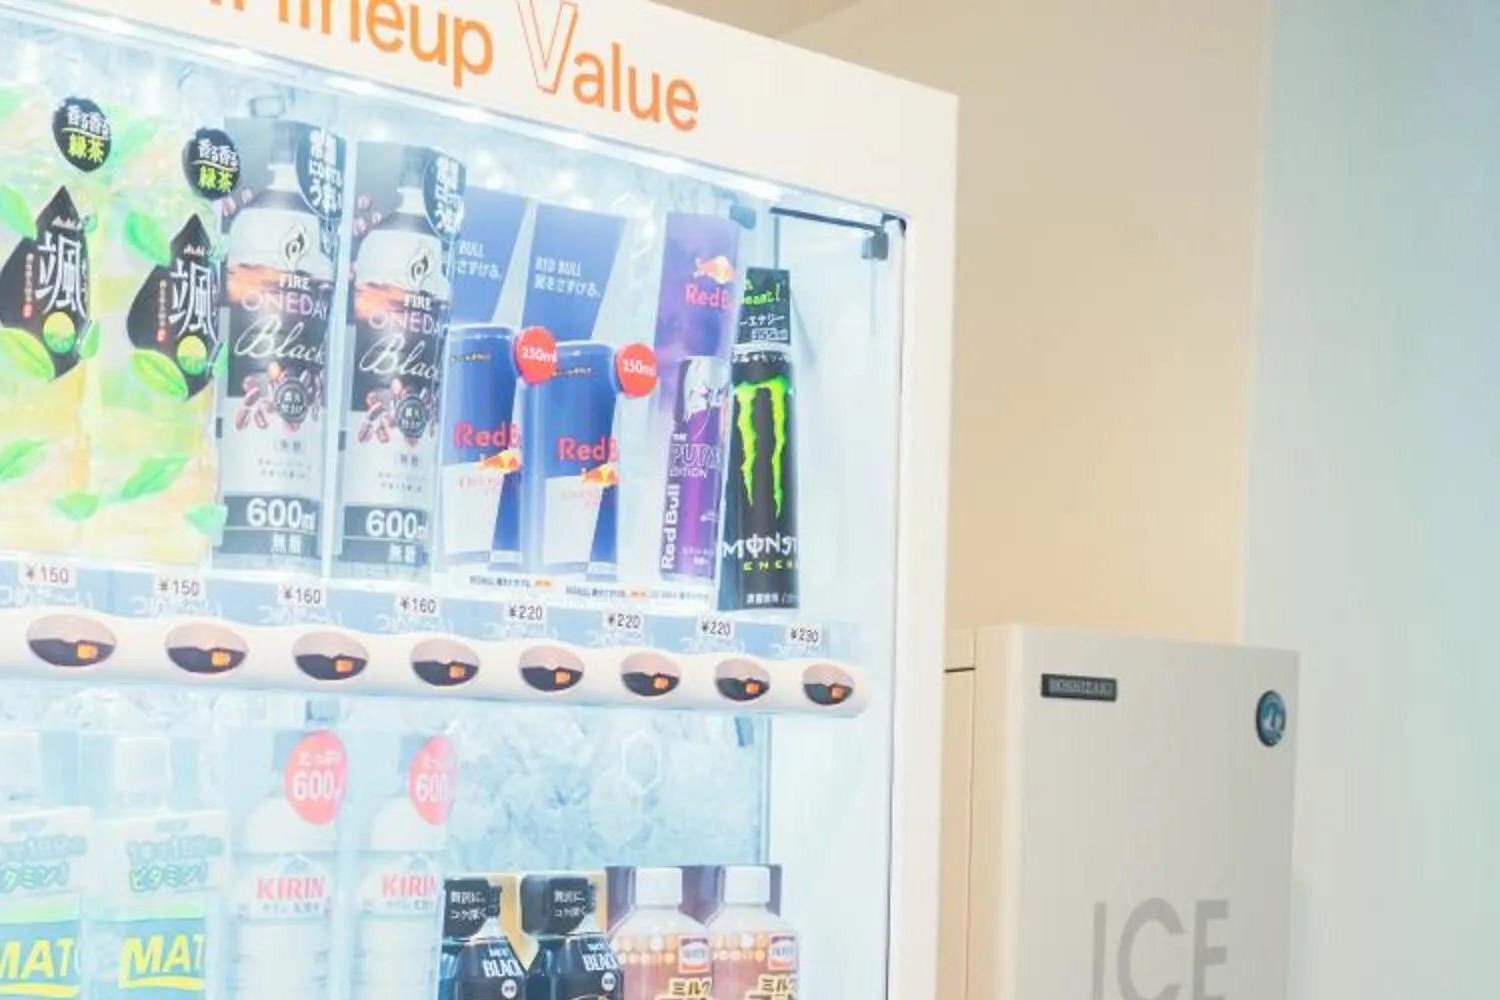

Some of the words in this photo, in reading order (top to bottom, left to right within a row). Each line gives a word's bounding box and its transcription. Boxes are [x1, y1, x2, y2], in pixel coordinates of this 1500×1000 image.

[517, 0, 700, 132] Value
[36, 232, 88, 317] 颯
[279, 273, 310, 291] FIRE
[169, 259, 219, 343] 颯
[403, 294, 432, 311] FIRE
[248, 498, 316, 531] 600ml
[25, 565, 70, 586] ¥150
[157, 579, 200, 597] ¥150
[256, 874, 326, 900] KIRIN
